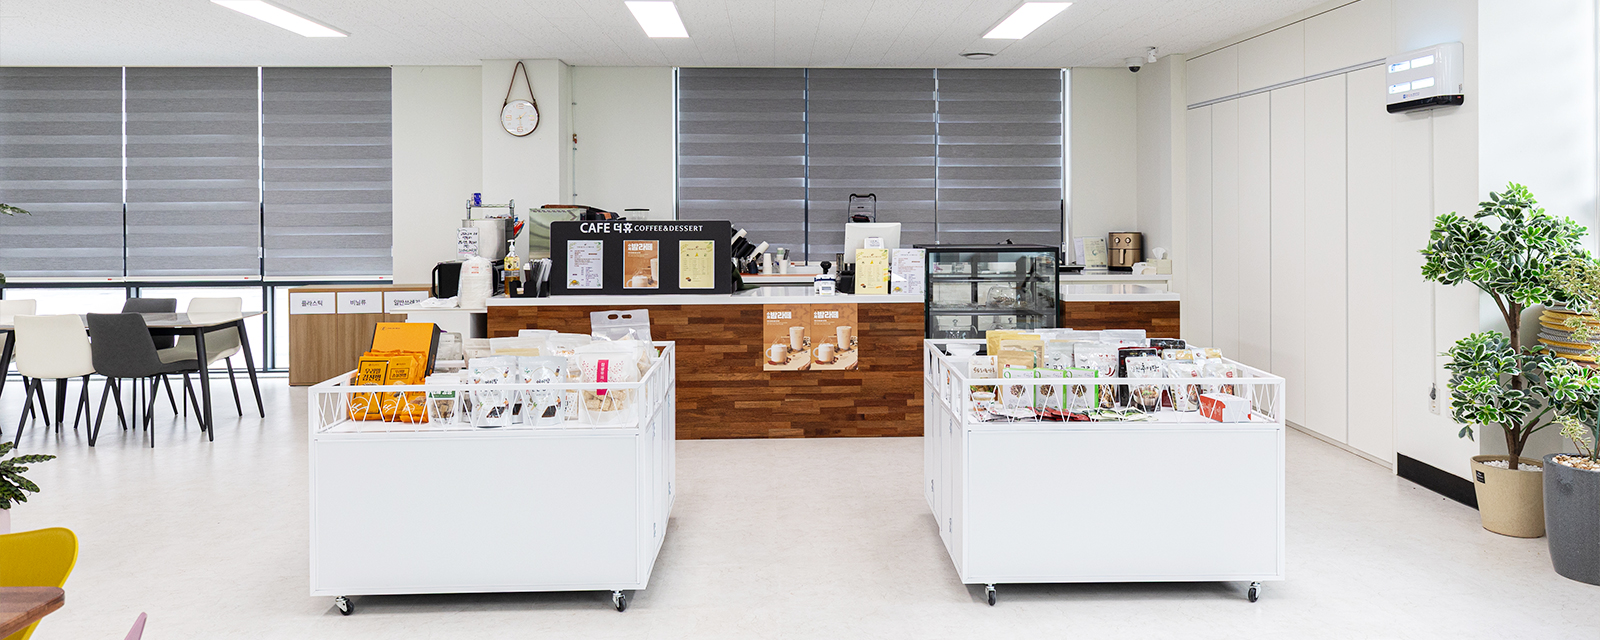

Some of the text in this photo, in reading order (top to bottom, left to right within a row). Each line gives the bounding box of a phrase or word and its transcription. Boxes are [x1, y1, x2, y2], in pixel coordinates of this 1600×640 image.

[580, 222, 703, 234] CAFE 더휴 COFFEE&DESSERT
